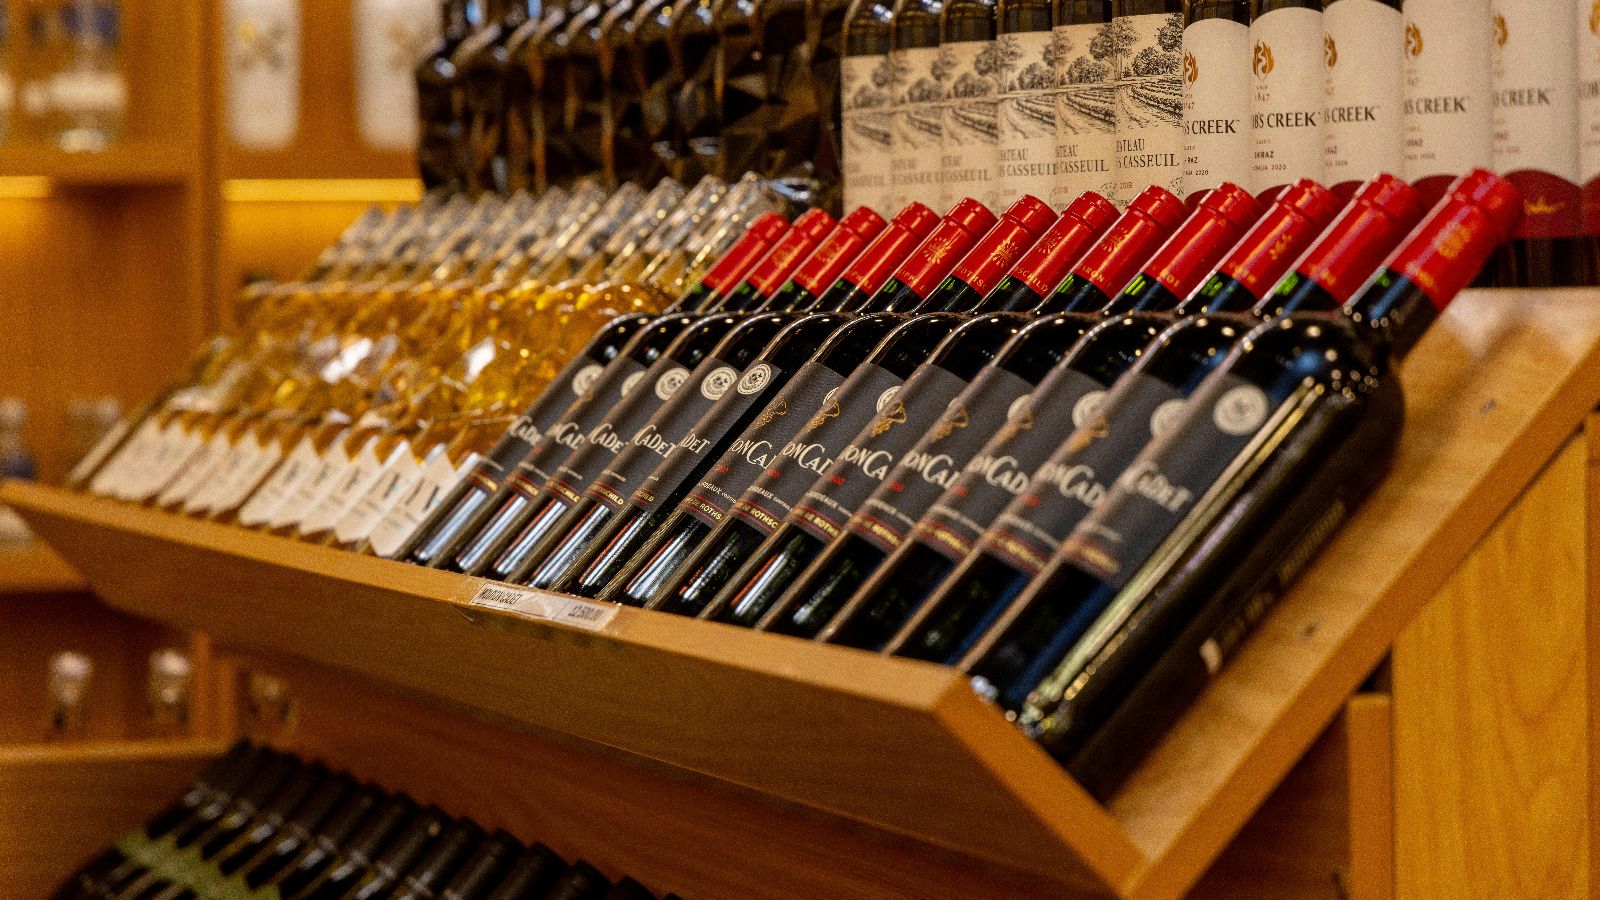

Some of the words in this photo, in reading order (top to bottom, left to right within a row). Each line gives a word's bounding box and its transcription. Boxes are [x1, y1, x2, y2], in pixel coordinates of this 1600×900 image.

[1415, 97, 1467, 113] CREEK
[1266, 111, 1317, 129] CREEK
[1331, 105, 1376, 124] CREEK
[1191, 118, 1237, 136] CREEK
[1123, 153, 1180, 169] CASSEUIL
